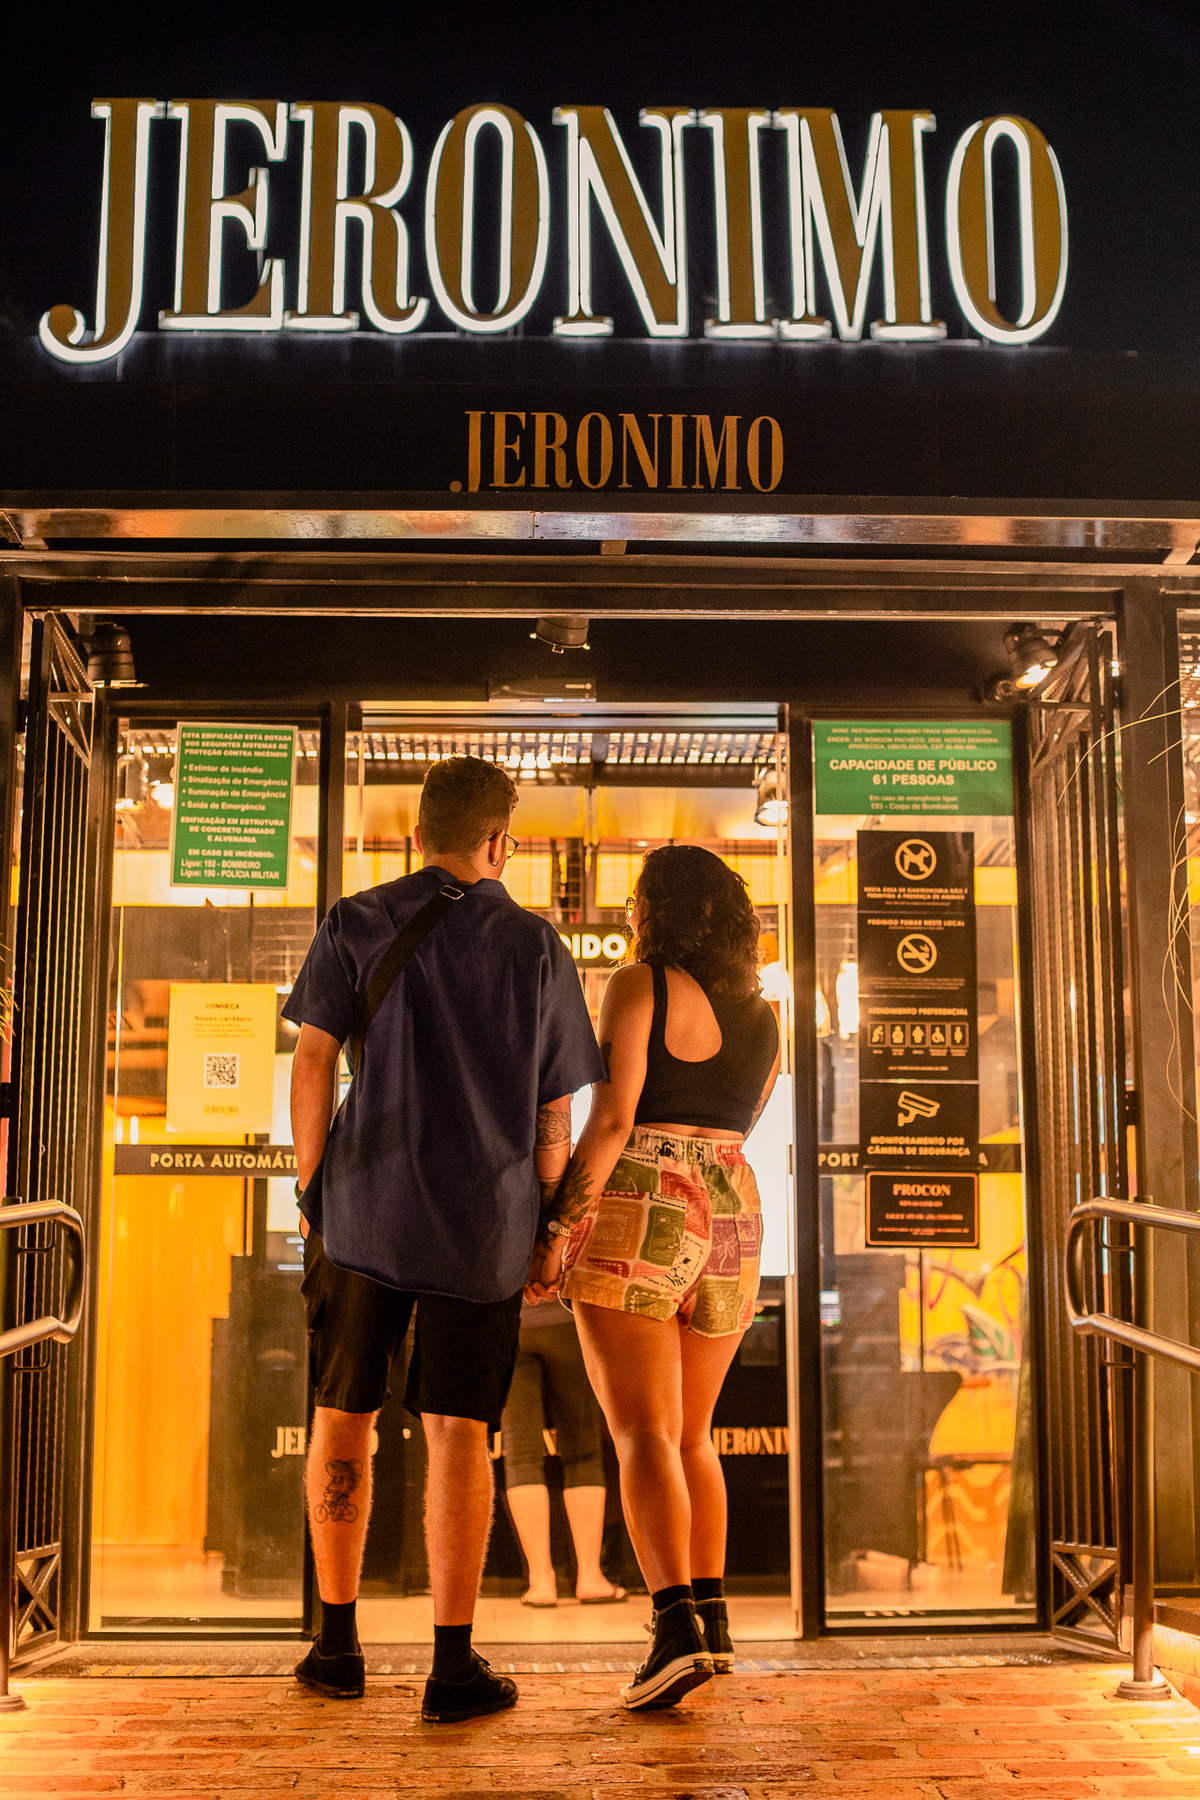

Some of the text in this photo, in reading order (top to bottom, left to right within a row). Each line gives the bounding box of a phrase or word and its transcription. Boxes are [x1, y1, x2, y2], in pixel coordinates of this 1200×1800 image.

[38, 97, 1069, 364] JERONIMO
[450, 410, 784, 493] JERONIMO
[254, 750, 288, 758] INCÊNDIO
[188, 764, 218, 773] Extintor
[231, 765, 264, 774] incêndio
[830, 758, 997, 771] CAPACIDADE DE PÚBLICO
[188, 776, 230, 785] Sinalização
[244, 779, 288, 787] Emergência
[873, 774, 954, 786] 61 PESSOAS
[242, 790, 286, 799] Emergência
[187, 800, 208, 809] Saída
[221, 802, 266, 812] Emergência
[180, 816, 225, 825] EDIFICAÇÃO
[181, 859, 202, 868] Ligue:
[222, 861, 260, 869] BOMBEIRO
[180, 868, 202, 878] Ligue:
[221, 869, 249, 879] POLÍCIA
[251, 871, 280, 880] MILITAR
[947, 1137, 965, 1146] POR
[867, 1145, 970, 1157] CÂMERA DE SEGURANÇA
[150, 1151, 298, 1168] PORTA AUTOMÁTI
[818, 1153, 859, 1167] PORT
[893, 1184, 950, 1196] PROCON
